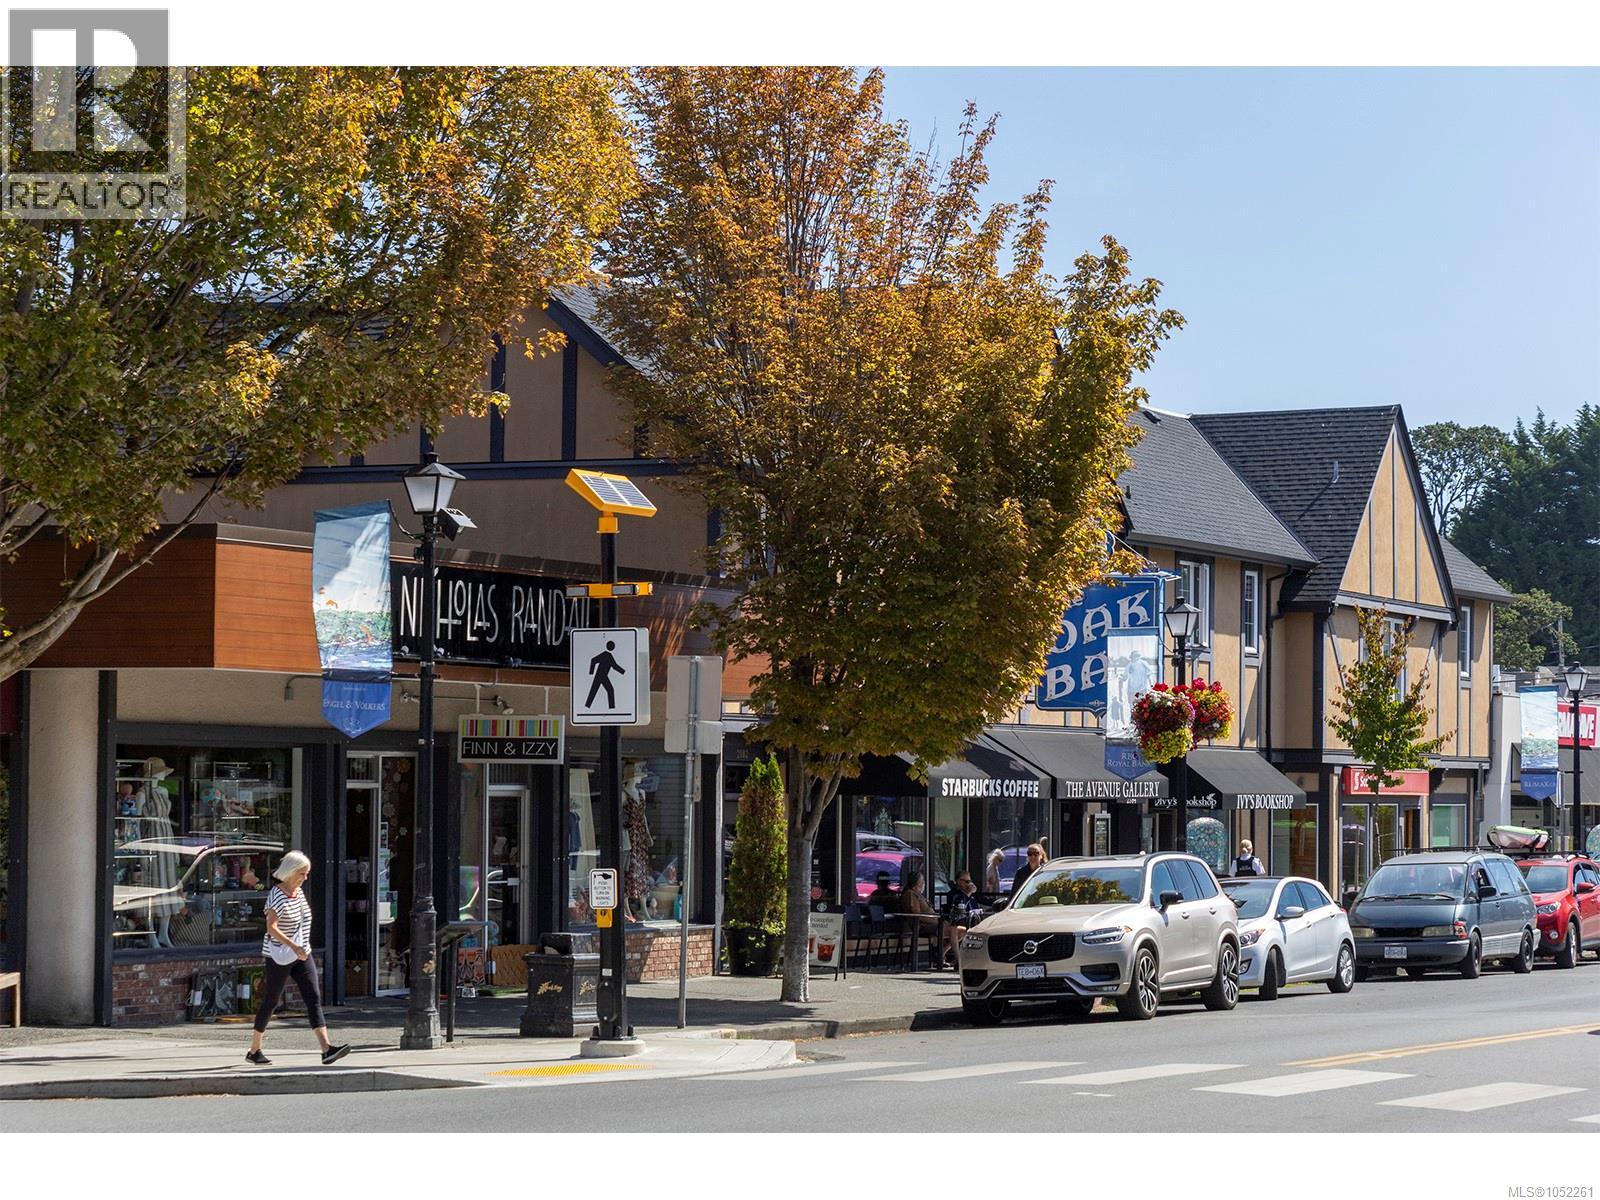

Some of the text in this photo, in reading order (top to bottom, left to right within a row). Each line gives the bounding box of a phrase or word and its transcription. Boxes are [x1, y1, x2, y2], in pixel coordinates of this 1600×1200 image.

[400, 575, 499, 643] NIHOLAS
[1043, 650, 1108, 702] BA
[345, 700, 353, 710] &
[463, 741, 557, 756] FINN & IZZY
[1107, 759, 1131, 767] ROYAL
[941, 778, 1040, 798] STARBUCKS COFFEE
[1066, 781, 1160, 798] THE AVENUE GALLERY
[1237, 794, 1294, 809] IVY'S BOOKSHOP
